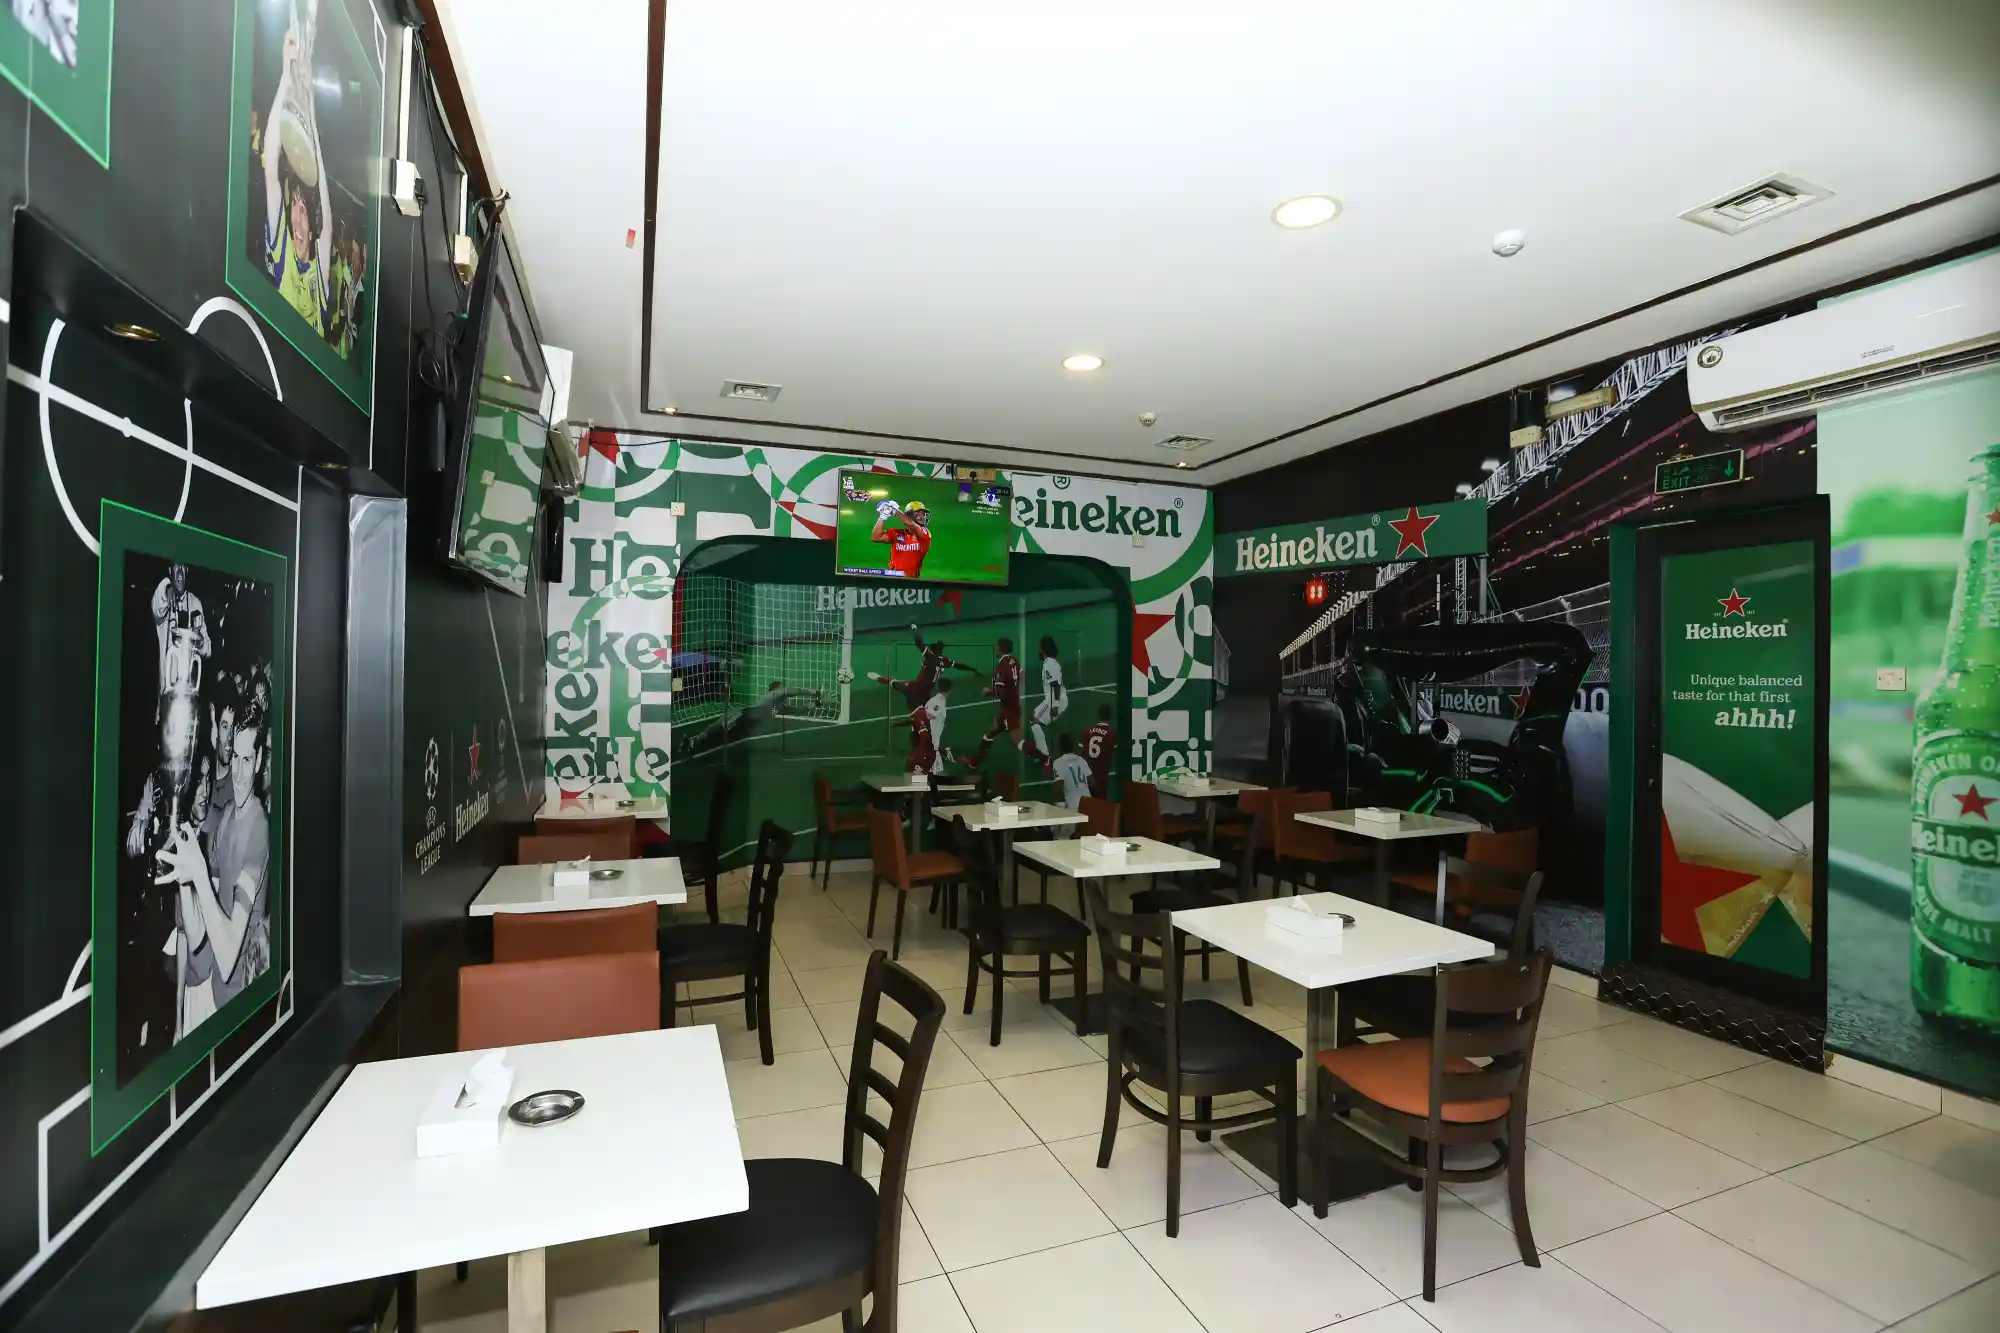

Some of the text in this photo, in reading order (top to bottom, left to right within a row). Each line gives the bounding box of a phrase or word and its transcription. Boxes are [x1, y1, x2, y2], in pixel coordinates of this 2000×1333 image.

[1662, 475, 1691, 489] EXIT
[1236, 525, 1378, 572] Heineken
[1685, 621, 1788, 640] Heineken
[1690, 673, 1803, 690] Unique balanced
[1424, 687, 1501, 715] Hineken
[1672, 689, 1790, 703] taste for that first
[1714, 707, 1796, 729] ahhh!
[1088, 735, 1103, 758] 6
[455, 790, 489, 843] Heineken
[415, 821, 446, 859] CHAMPIONS
[420, 844, 441, 876] LEAGUE
